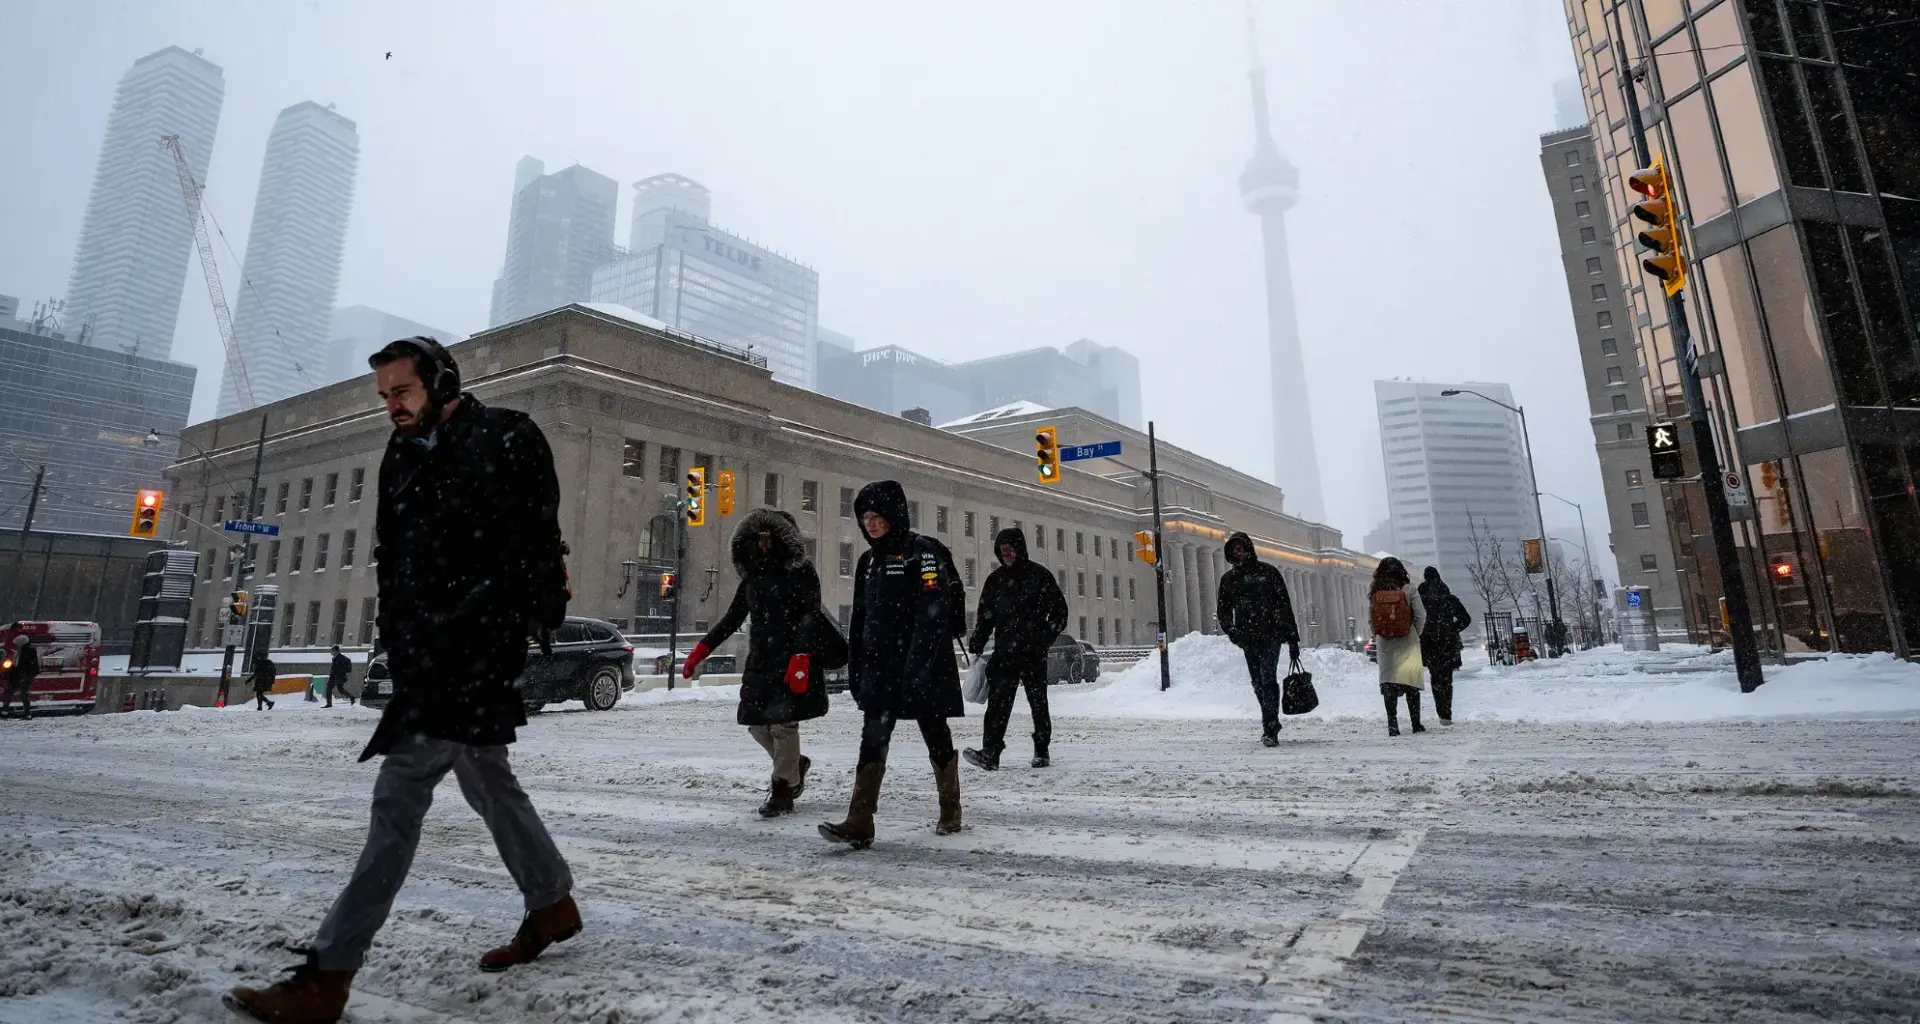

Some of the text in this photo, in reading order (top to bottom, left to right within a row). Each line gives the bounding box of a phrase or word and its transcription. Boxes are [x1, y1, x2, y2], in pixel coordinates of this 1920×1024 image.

[704, 235, 764, 271] TELUS
[862, 349, 890, 367] pwc
[895, 349, 917, 365] pwc
[1077, 447, 1094, 457] Bay
[235, 522, 255, 532] Front
[649, 607, 657, 615] 61
